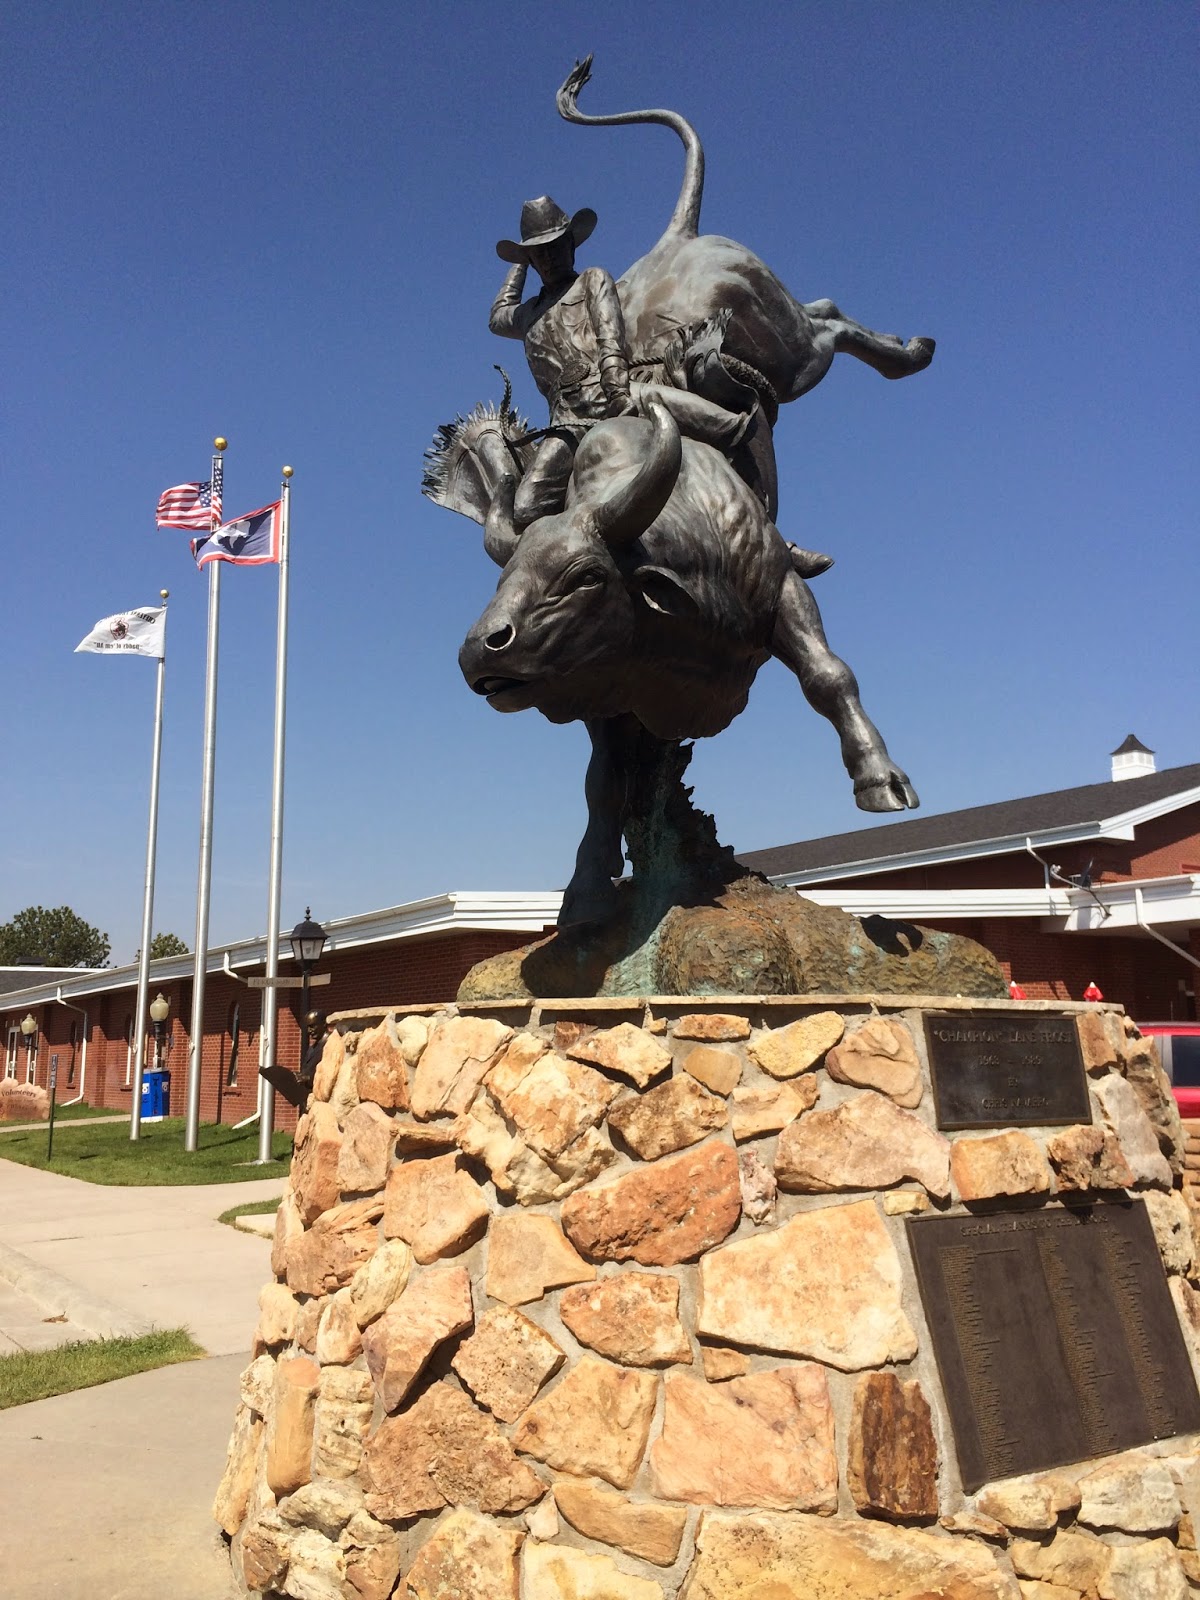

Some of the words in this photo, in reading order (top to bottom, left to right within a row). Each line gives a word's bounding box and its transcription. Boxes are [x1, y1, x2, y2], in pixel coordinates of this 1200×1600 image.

[1009, 1031, 1037, 1044] LANE
[1041, 1031, 1073, 1044] FROST
[1, 1088, 36, 1098] Volunteers
[961, 1224, 1000, 1237] SPECIAL
